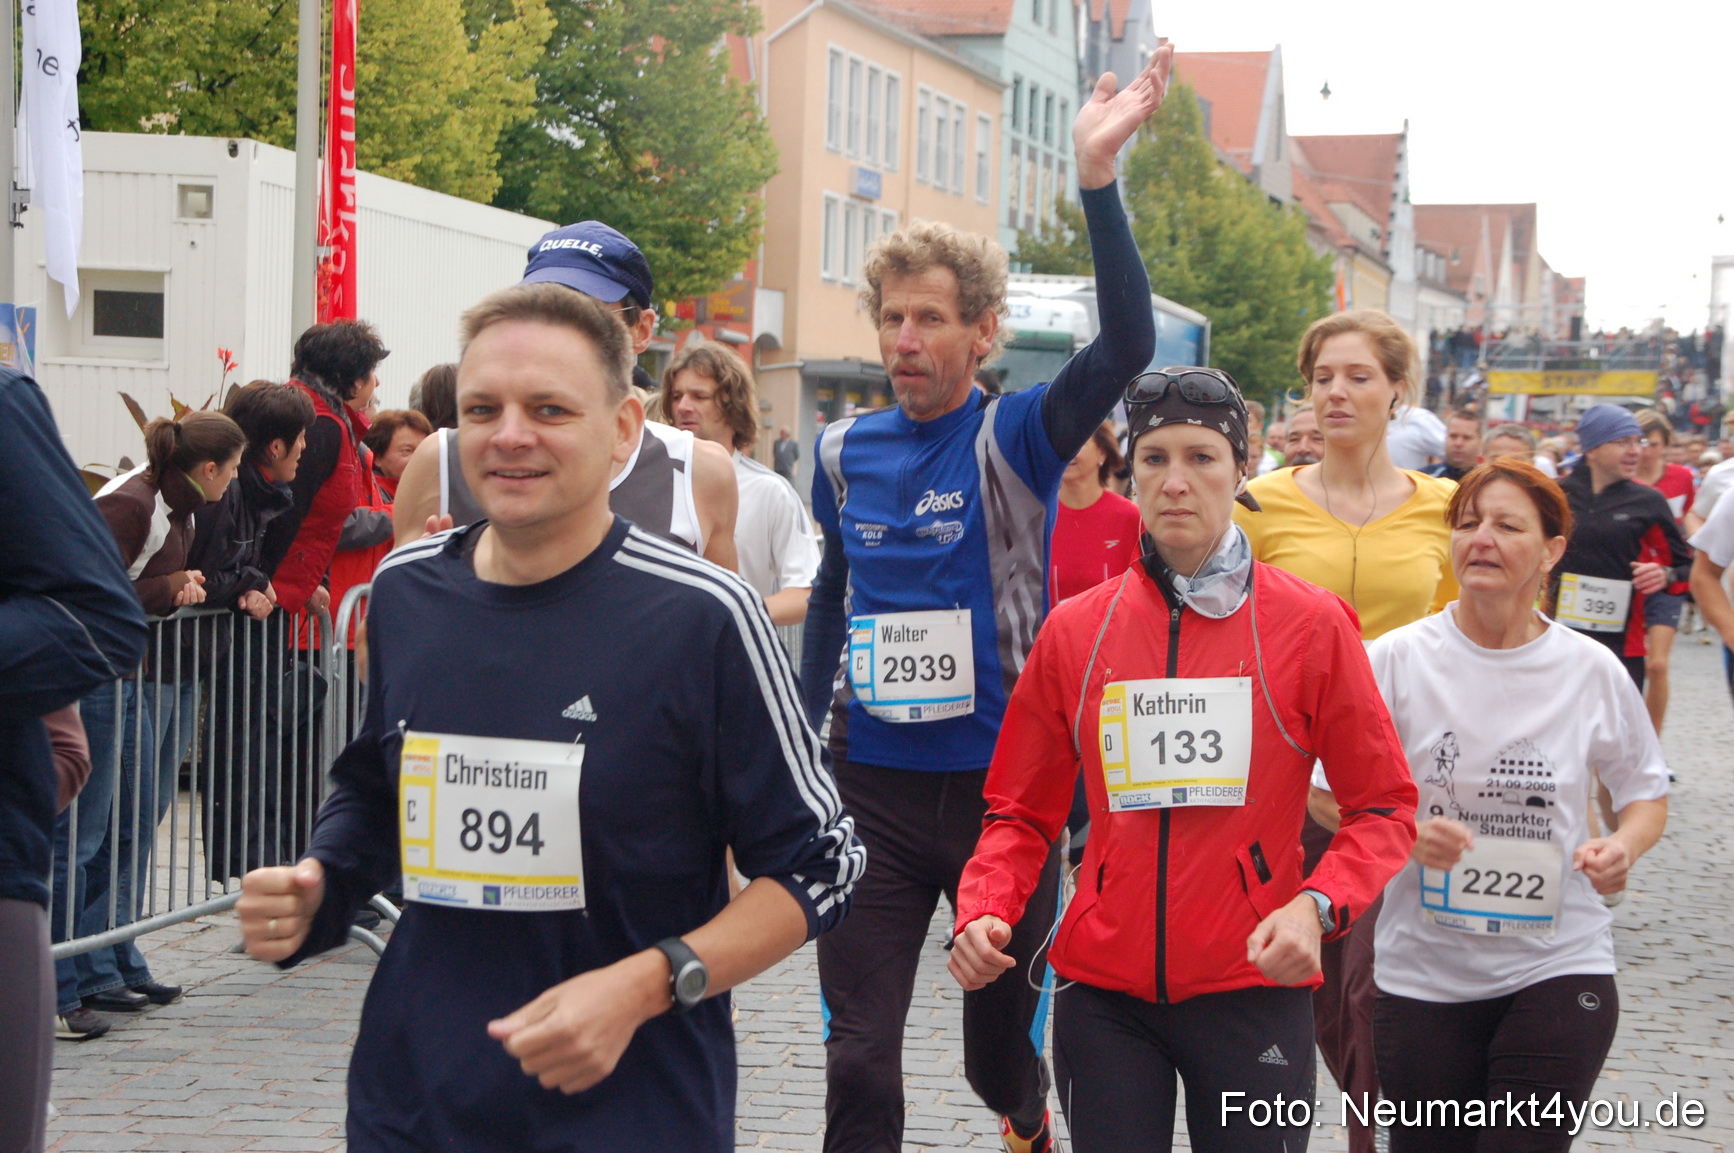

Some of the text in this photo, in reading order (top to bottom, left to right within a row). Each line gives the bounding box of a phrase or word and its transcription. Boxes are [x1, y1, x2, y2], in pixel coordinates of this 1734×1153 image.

[1542, 374, 1600, 390] START
[1583, 598, 1617, 615] 399
[882, 623, 928, 644] Walter
[856, 656, 864, 671] C
[883, 654, 957, 684] 2939
[1133, 691, 1206, 717] Kathrin
[1104, 733, 1113, 752] D
[1150, 729, 1224, 766] 133
[445, 753, 549, 791] Christian
[1189, 786, 1244, 797] PFLEIDERER
[1486, 778, 1556, 793] 21.09.2008
[407, 799, 417, 823] C
[1458, 811, 1553, 826] Neumarkter
[459, 807, 546, 857] 894
[1479, 823, 1553, 841] Stadtlauf
[1461, 867, 1545, 900] 2222
[503, 885, 579, 901] PFLEIDERER
[1258, 1056, 1289, 1066] adidas
